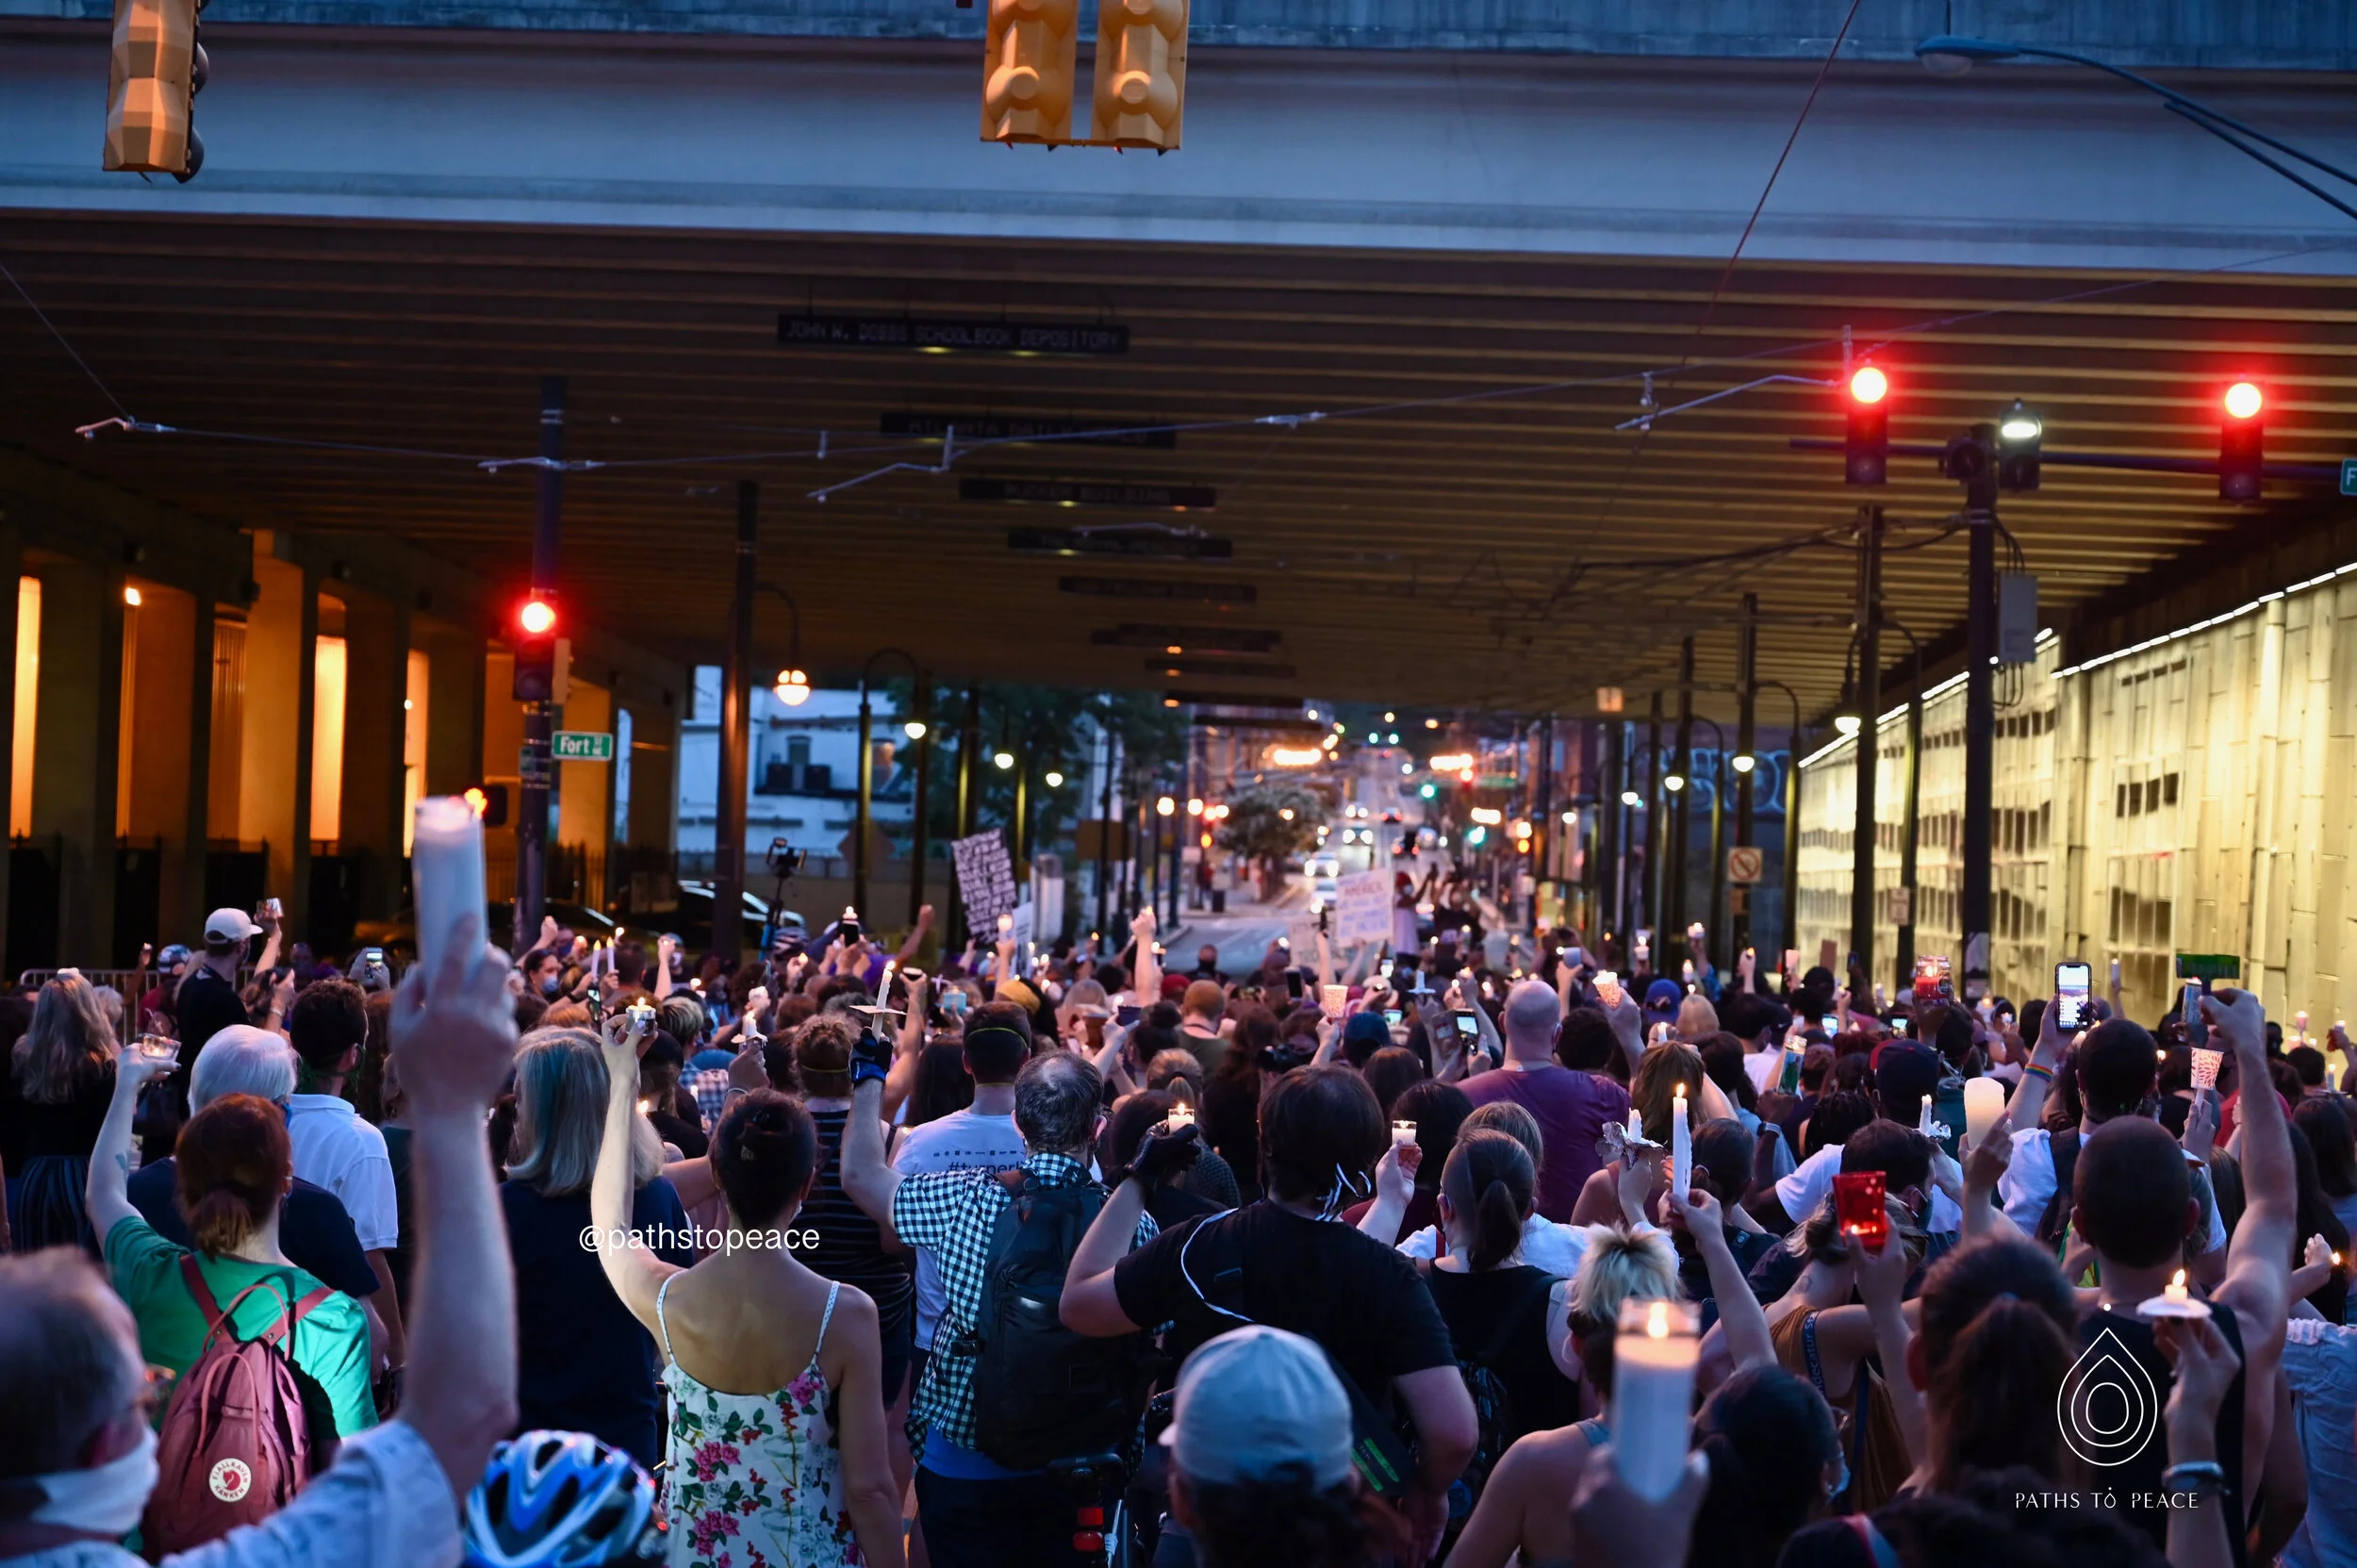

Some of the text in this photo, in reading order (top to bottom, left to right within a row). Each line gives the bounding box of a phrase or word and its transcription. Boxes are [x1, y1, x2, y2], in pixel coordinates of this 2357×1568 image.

[786, 321, 827, 338] JOHN
[832, 322, 849, 339] W.
[858, 322, 908, 341] DOBBS
[1020, 328, 1121, 349] DEPOSITORY
[561, 735, 589, 754] Fort
